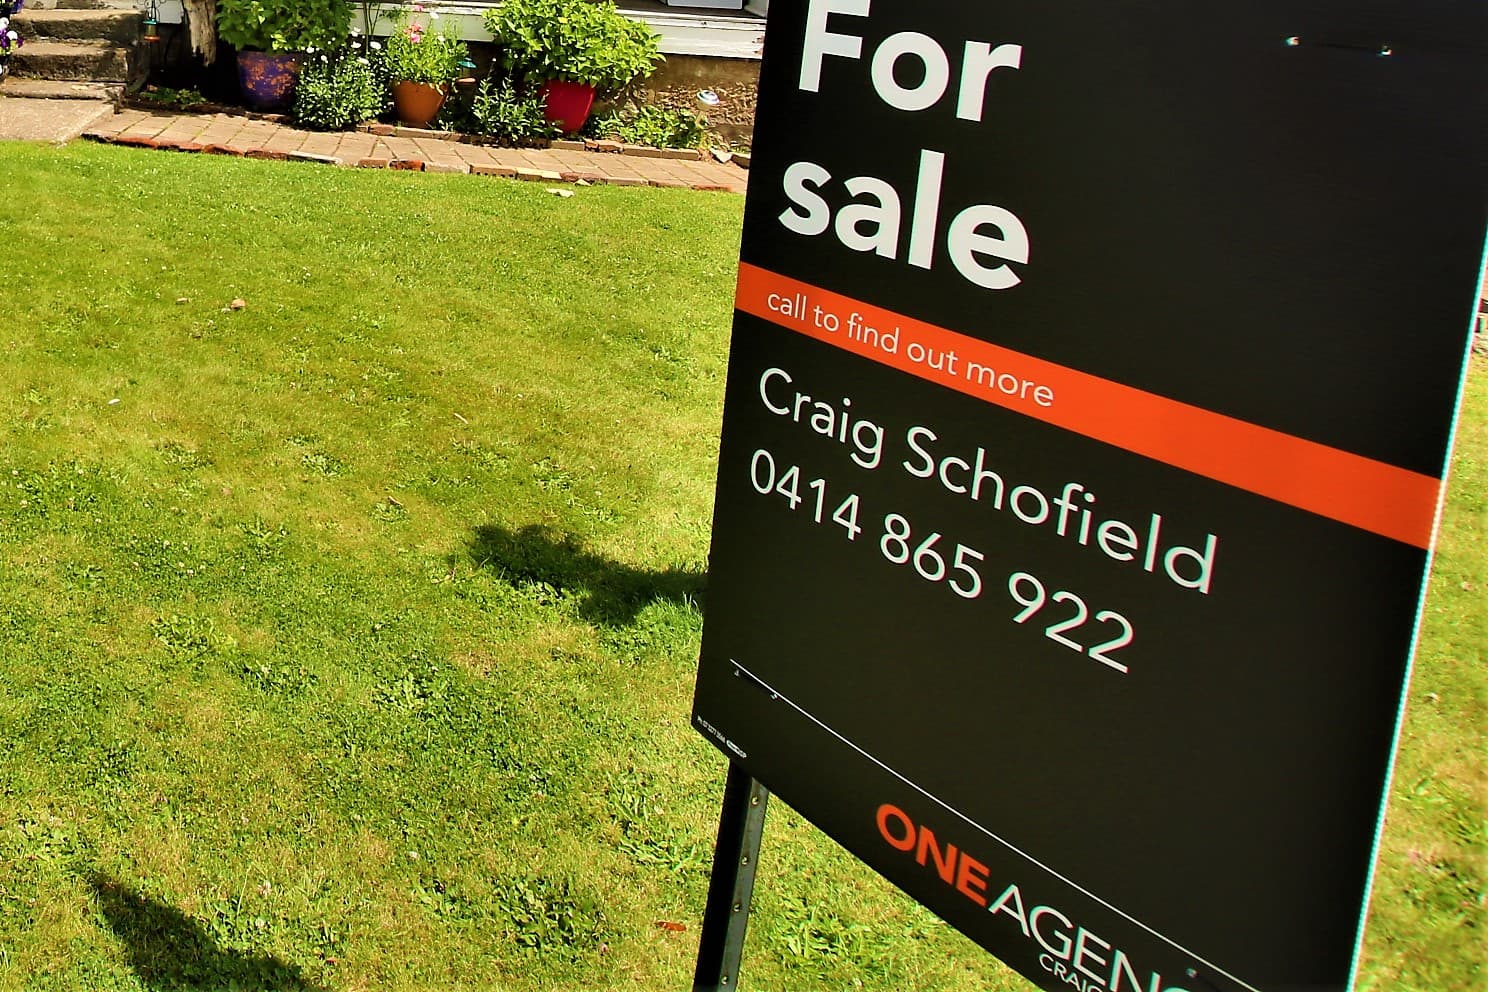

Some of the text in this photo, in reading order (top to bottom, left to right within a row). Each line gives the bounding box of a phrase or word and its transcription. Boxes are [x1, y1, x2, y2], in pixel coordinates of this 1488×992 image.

[778, 148, 1031, 291] sale
[766, 292, 1055, 408] call to find out more
[749, 448, 1135, 674] 0414 865 922
[758, 366, 1218, 595] Craig Schofield
[875, 803, 1193, 992] ONE AGEN
